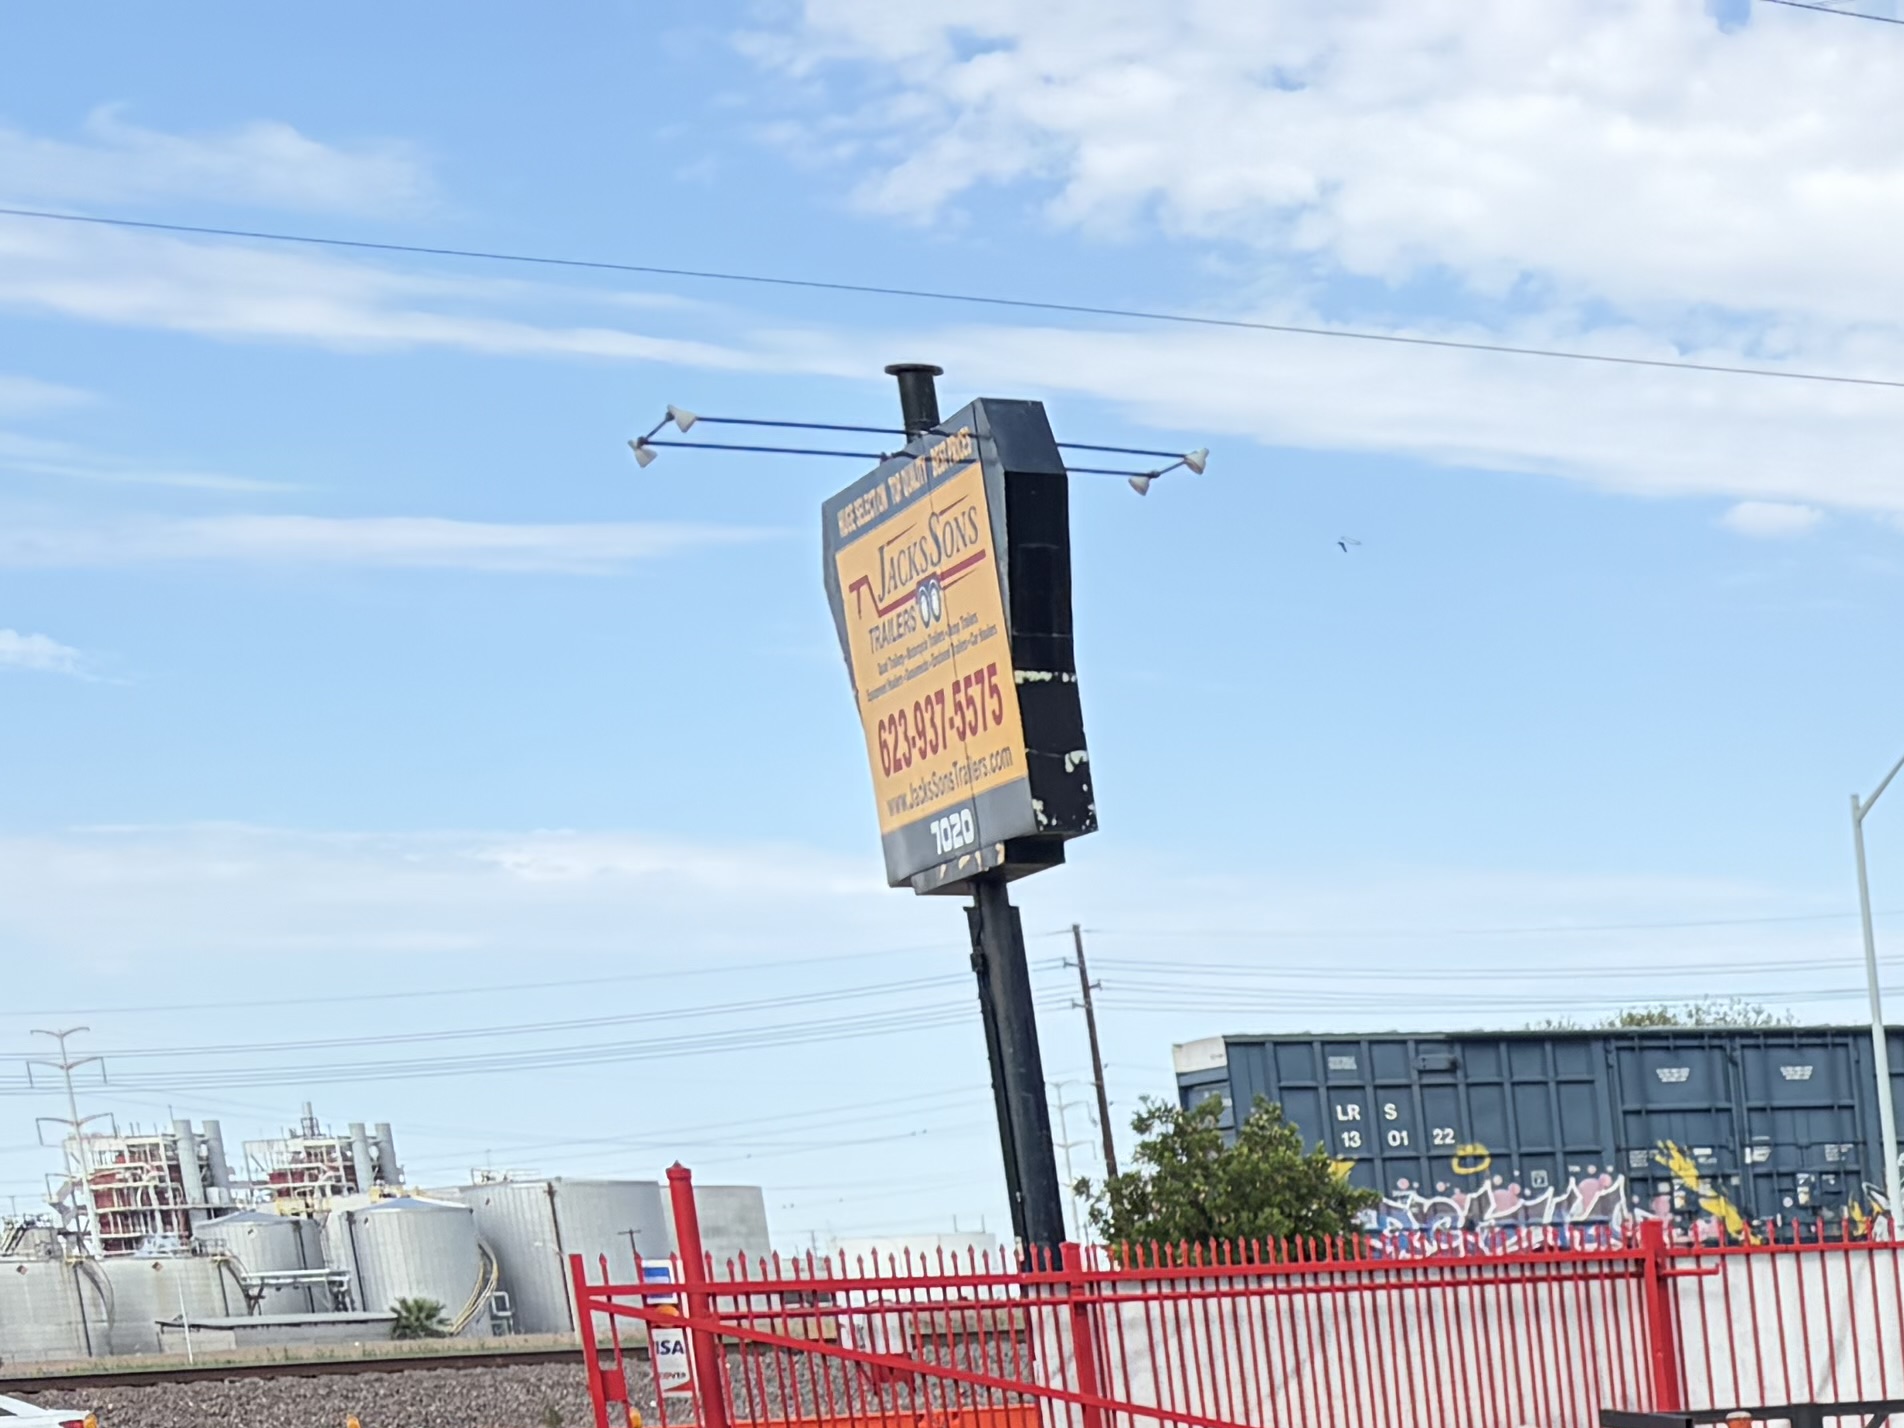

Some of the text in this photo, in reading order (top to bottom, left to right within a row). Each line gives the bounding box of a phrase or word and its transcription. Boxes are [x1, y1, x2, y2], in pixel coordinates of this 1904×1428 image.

[869, 604, 917, 655] TRAILERS
[878, 662, 1003, 778] 623-937-5575
[655, 1339, 685, 1356] ISA
